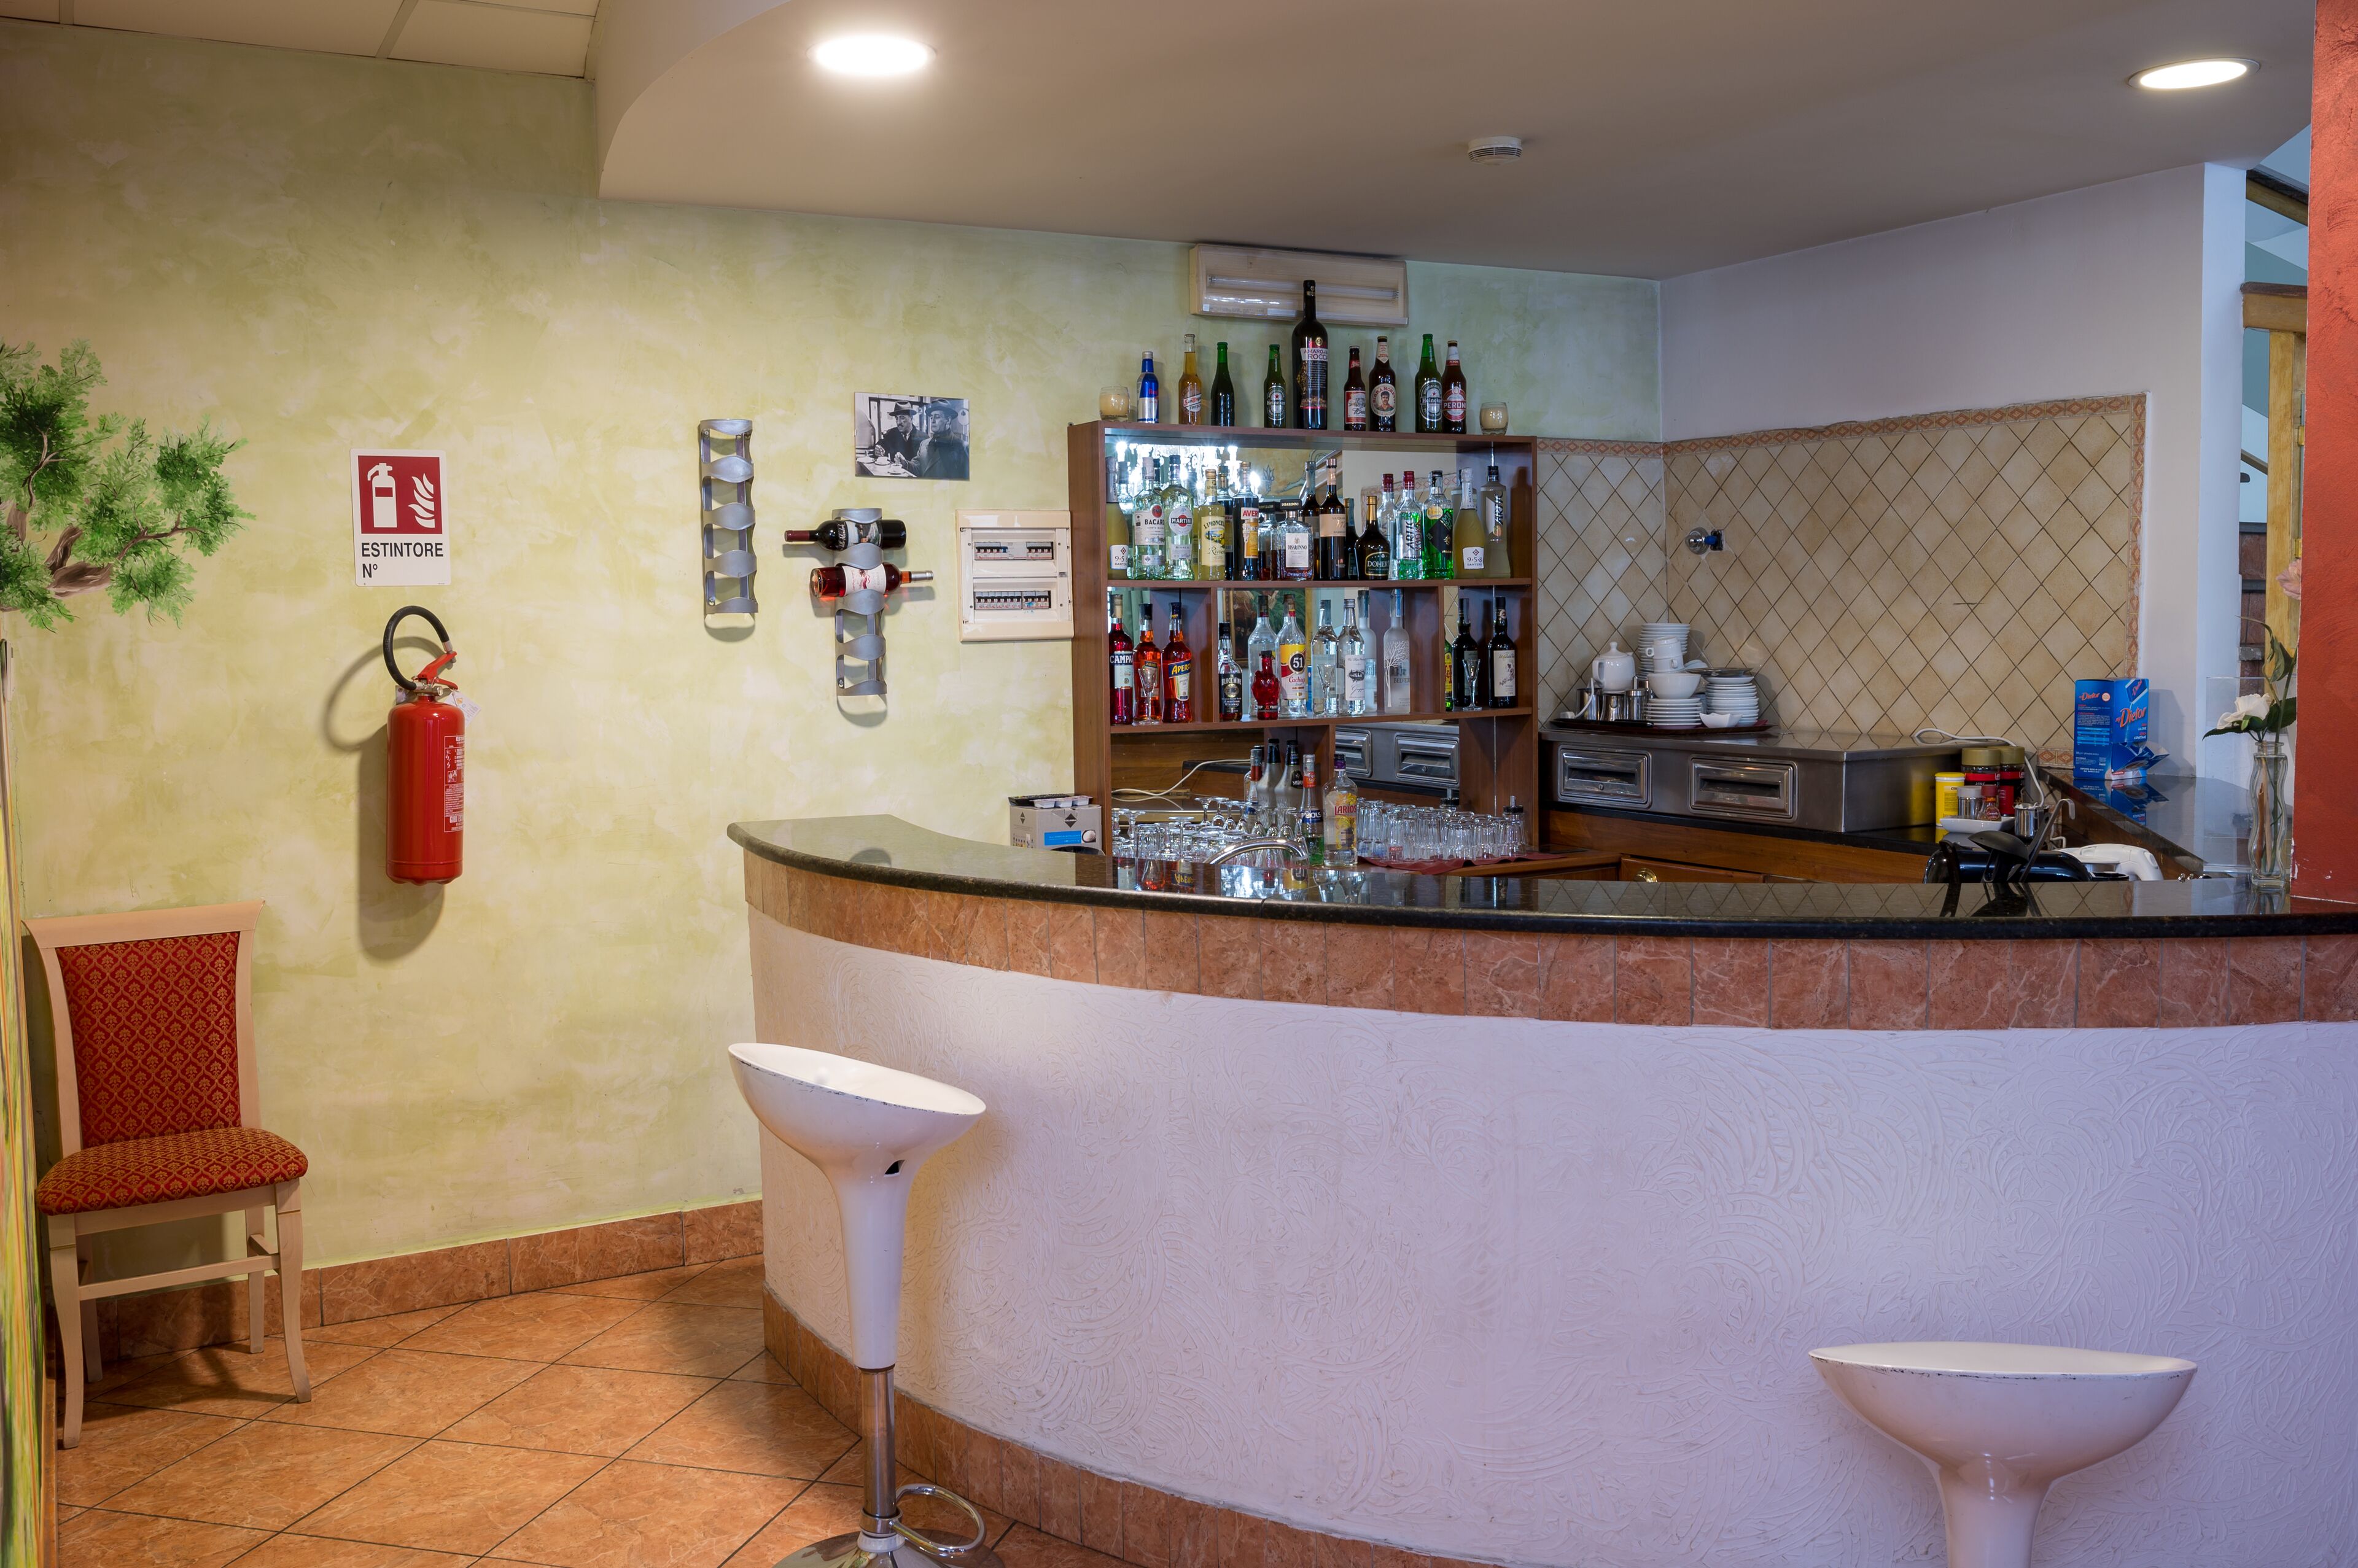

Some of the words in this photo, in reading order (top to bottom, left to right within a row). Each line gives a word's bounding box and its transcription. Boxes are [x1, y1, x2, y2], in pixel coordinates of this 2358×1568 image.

[1406, 520, 1415, 551] ARTIC
[361, 542, 444, 557] ESTINTORE
[1293, 657, 1303, 669] 51
[2082, 692, 2101, 701] Dietor
[2119, 707, 2147, 728] Dietor
[1334, 805, 1357, 816] LARIOS
